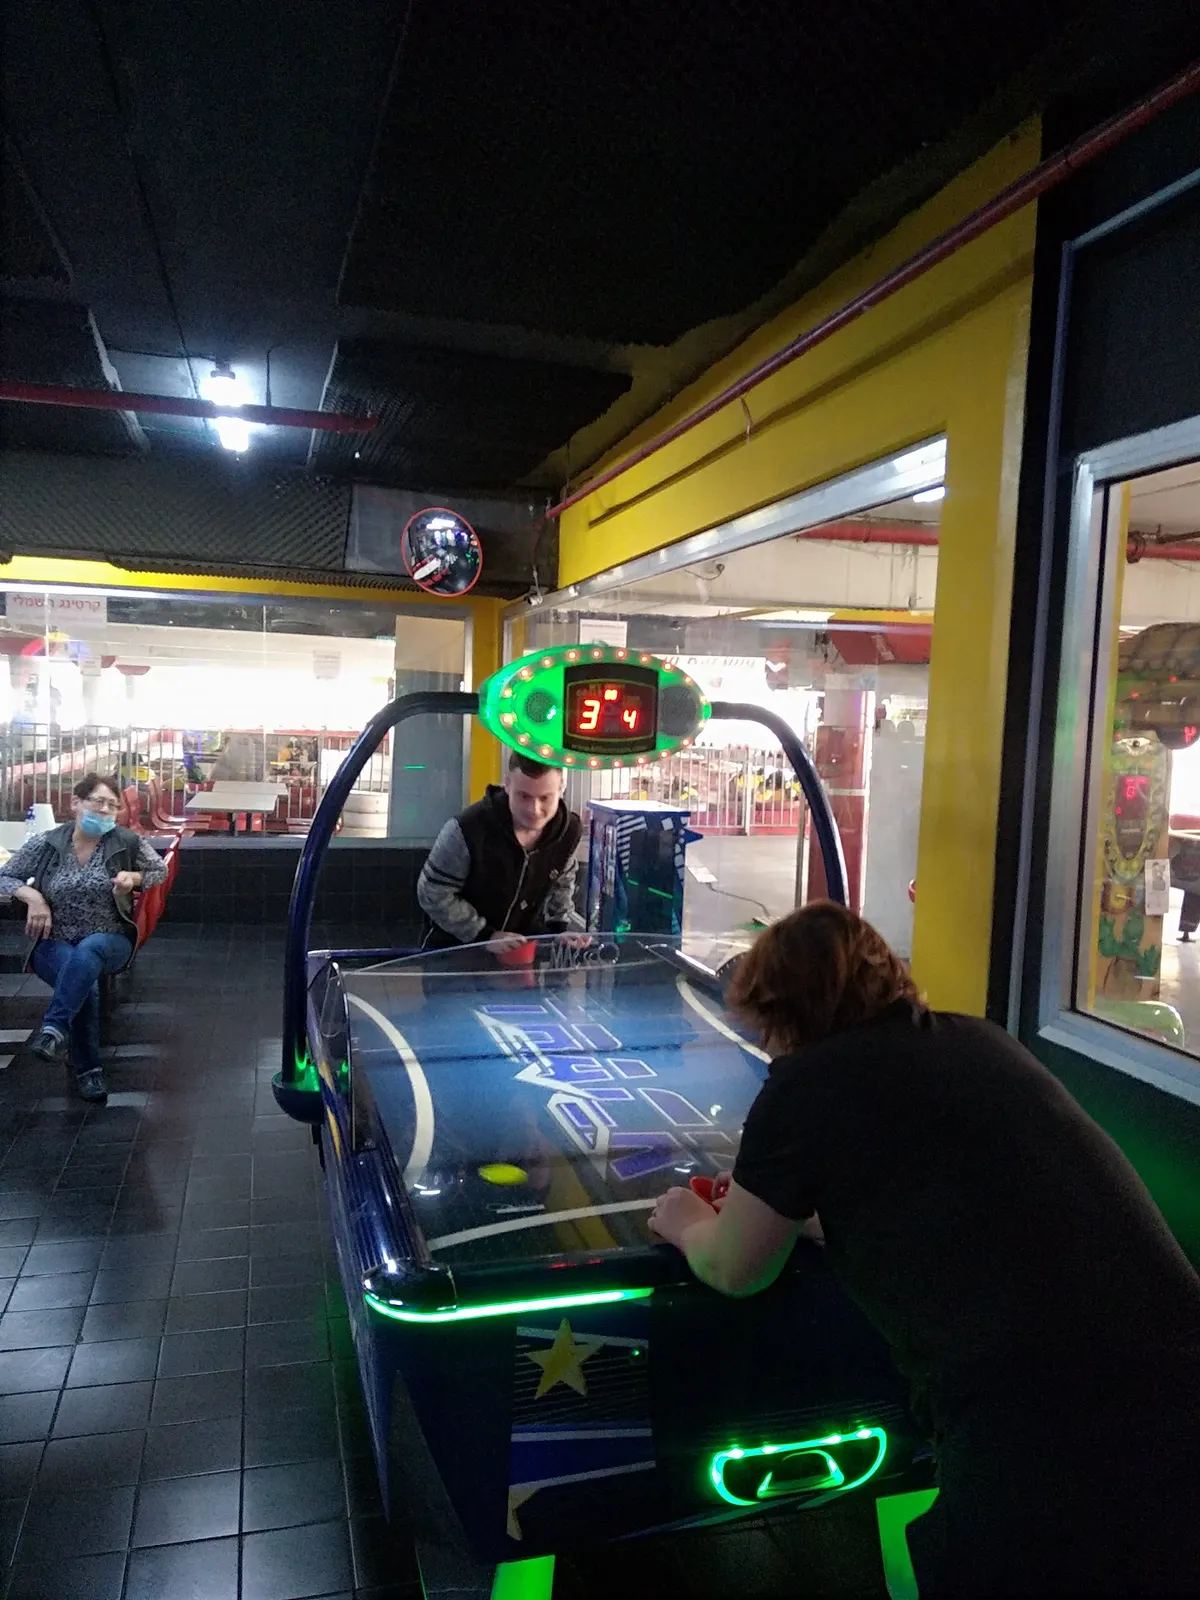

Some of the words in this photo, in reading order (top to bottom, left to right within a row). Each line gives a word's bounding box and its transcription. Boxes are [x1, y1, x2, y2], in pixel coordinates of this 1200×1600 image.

[59, 599, 101, 612] קרטינג
[579, 699, 601, 730] 3
[622, 708, 638, 730] 4
